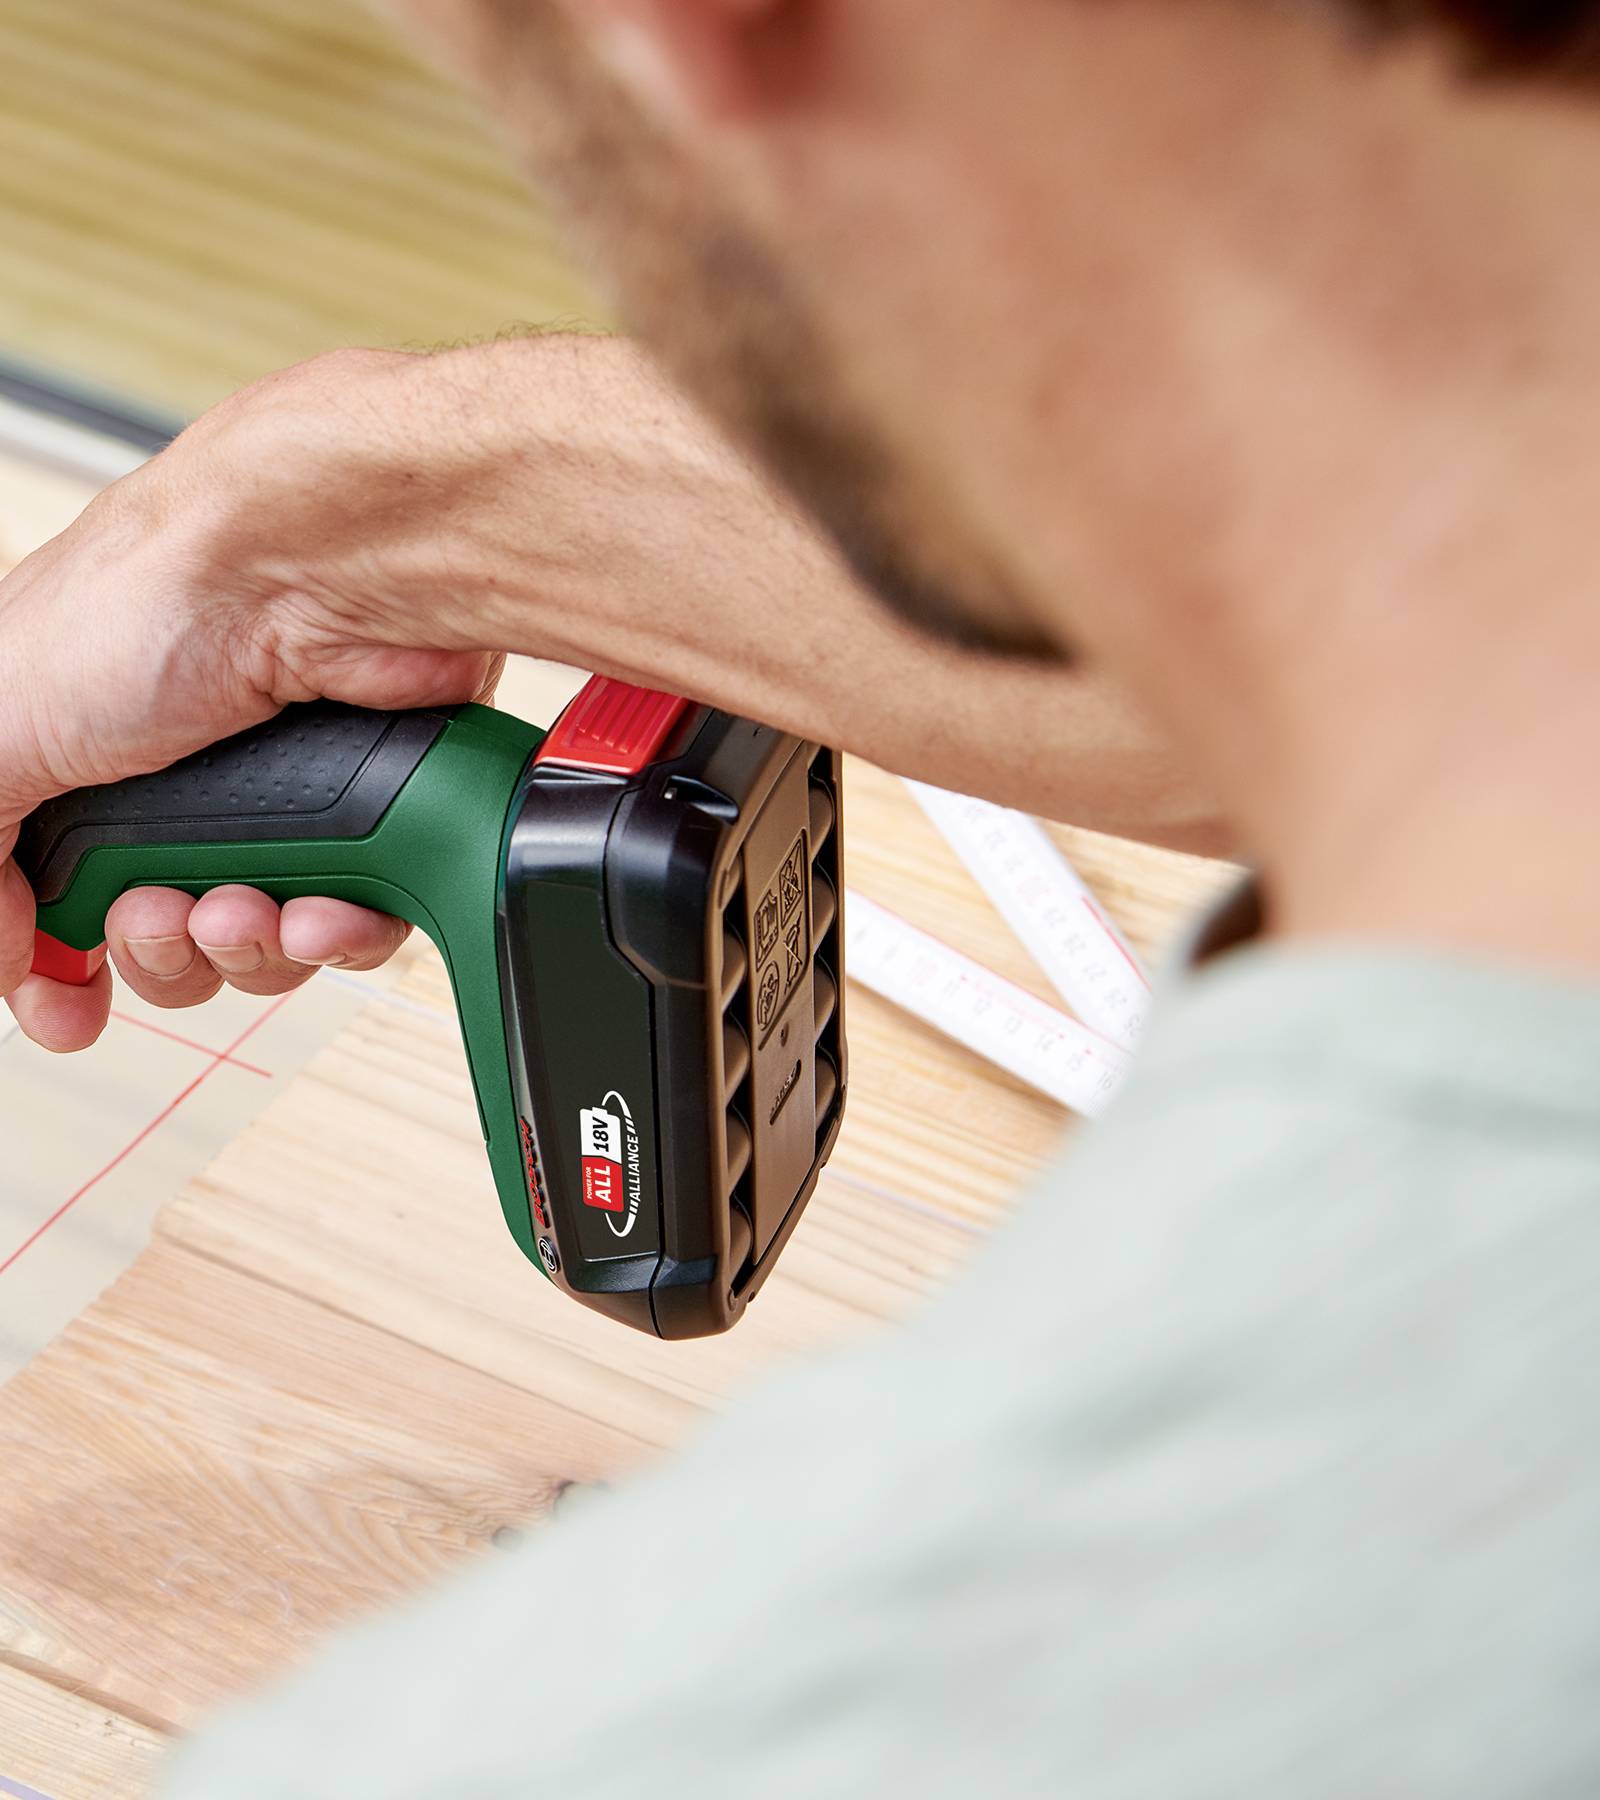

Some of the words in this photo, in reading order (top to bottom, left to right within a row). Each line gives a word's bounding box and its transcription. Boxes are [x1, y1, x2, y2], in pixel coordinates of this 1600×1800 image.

[592, 1116, 609, 1153] 18V
[594, 1165, 612, 1204] ALL
[626, 1134, 641, 1202] ALLIANCE
